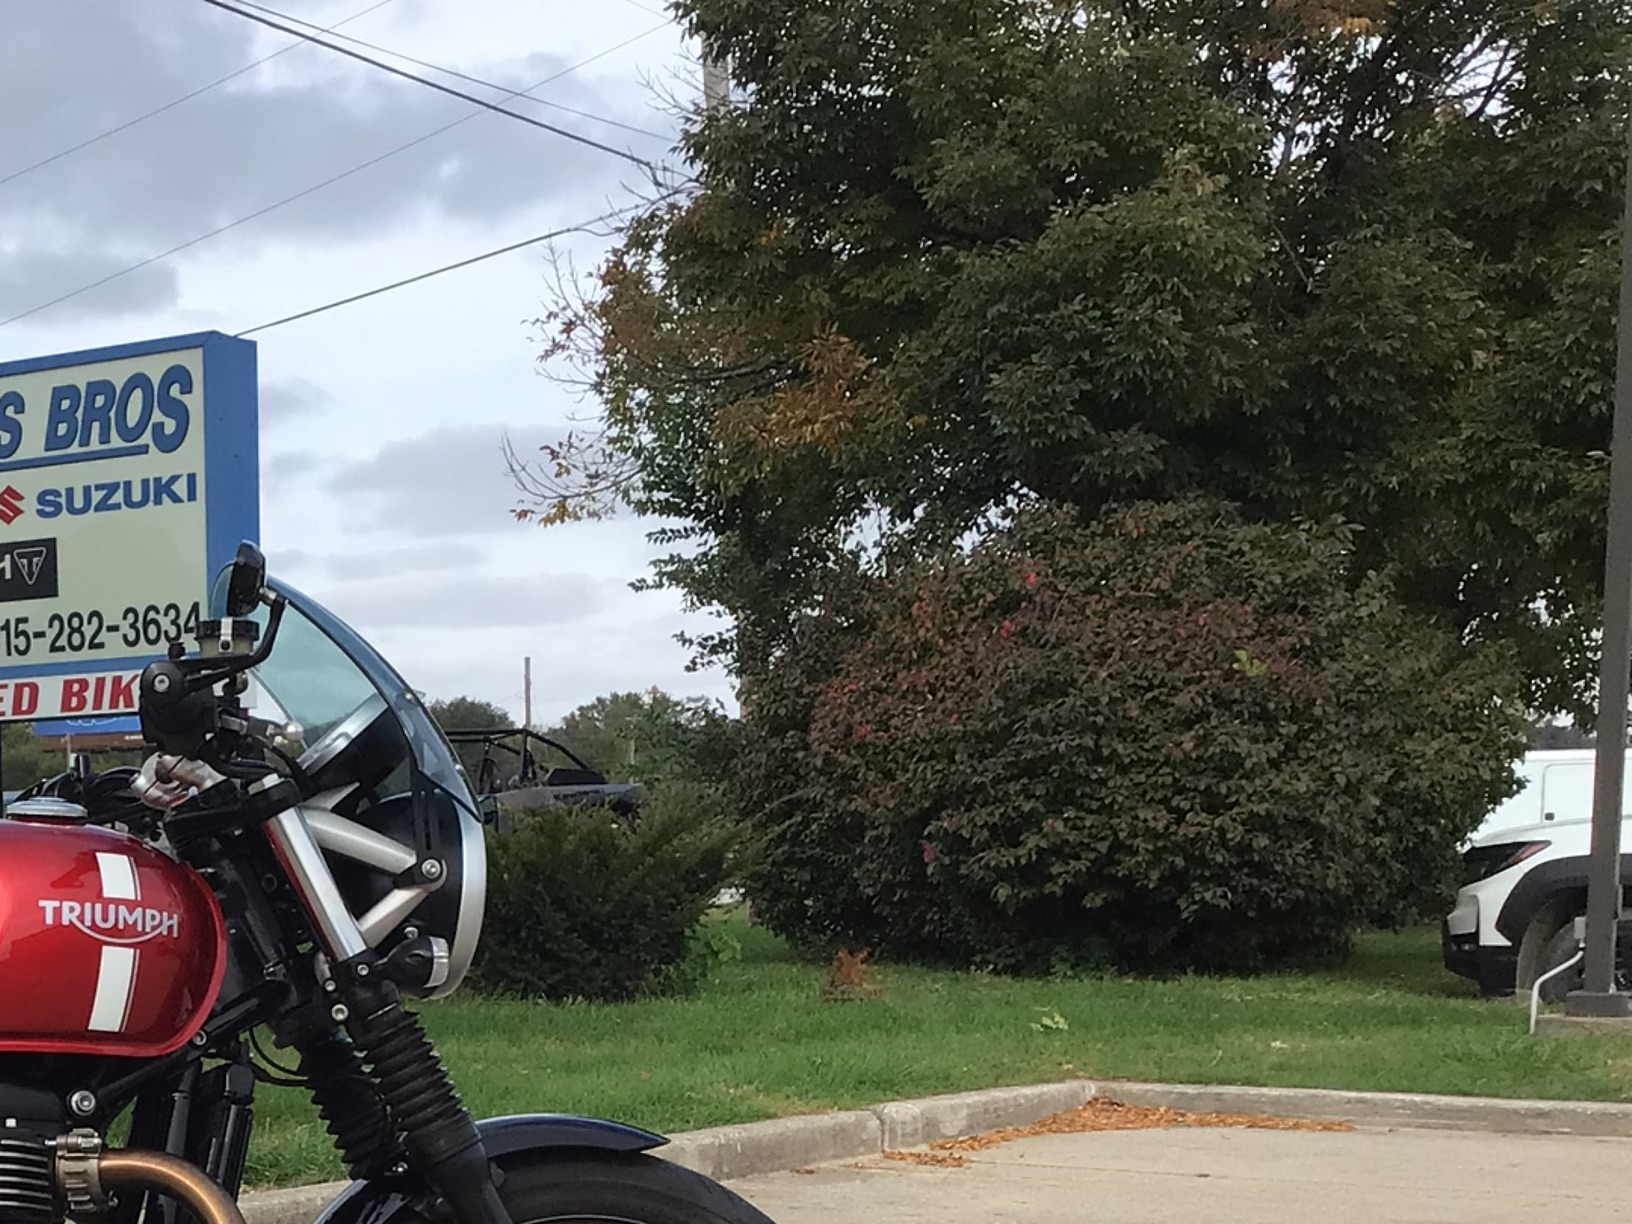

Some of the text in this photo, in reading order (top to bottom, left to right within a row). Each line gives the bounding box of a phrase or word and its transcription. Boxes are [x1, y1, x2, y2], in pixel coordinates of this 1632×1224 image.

[44, 364, 193, 453] BROS
[35, 472, 197, 518] SUZUKI
[60, 673, 141, 713] BIK
[38, 899, 178, 943] TRIUMPH
